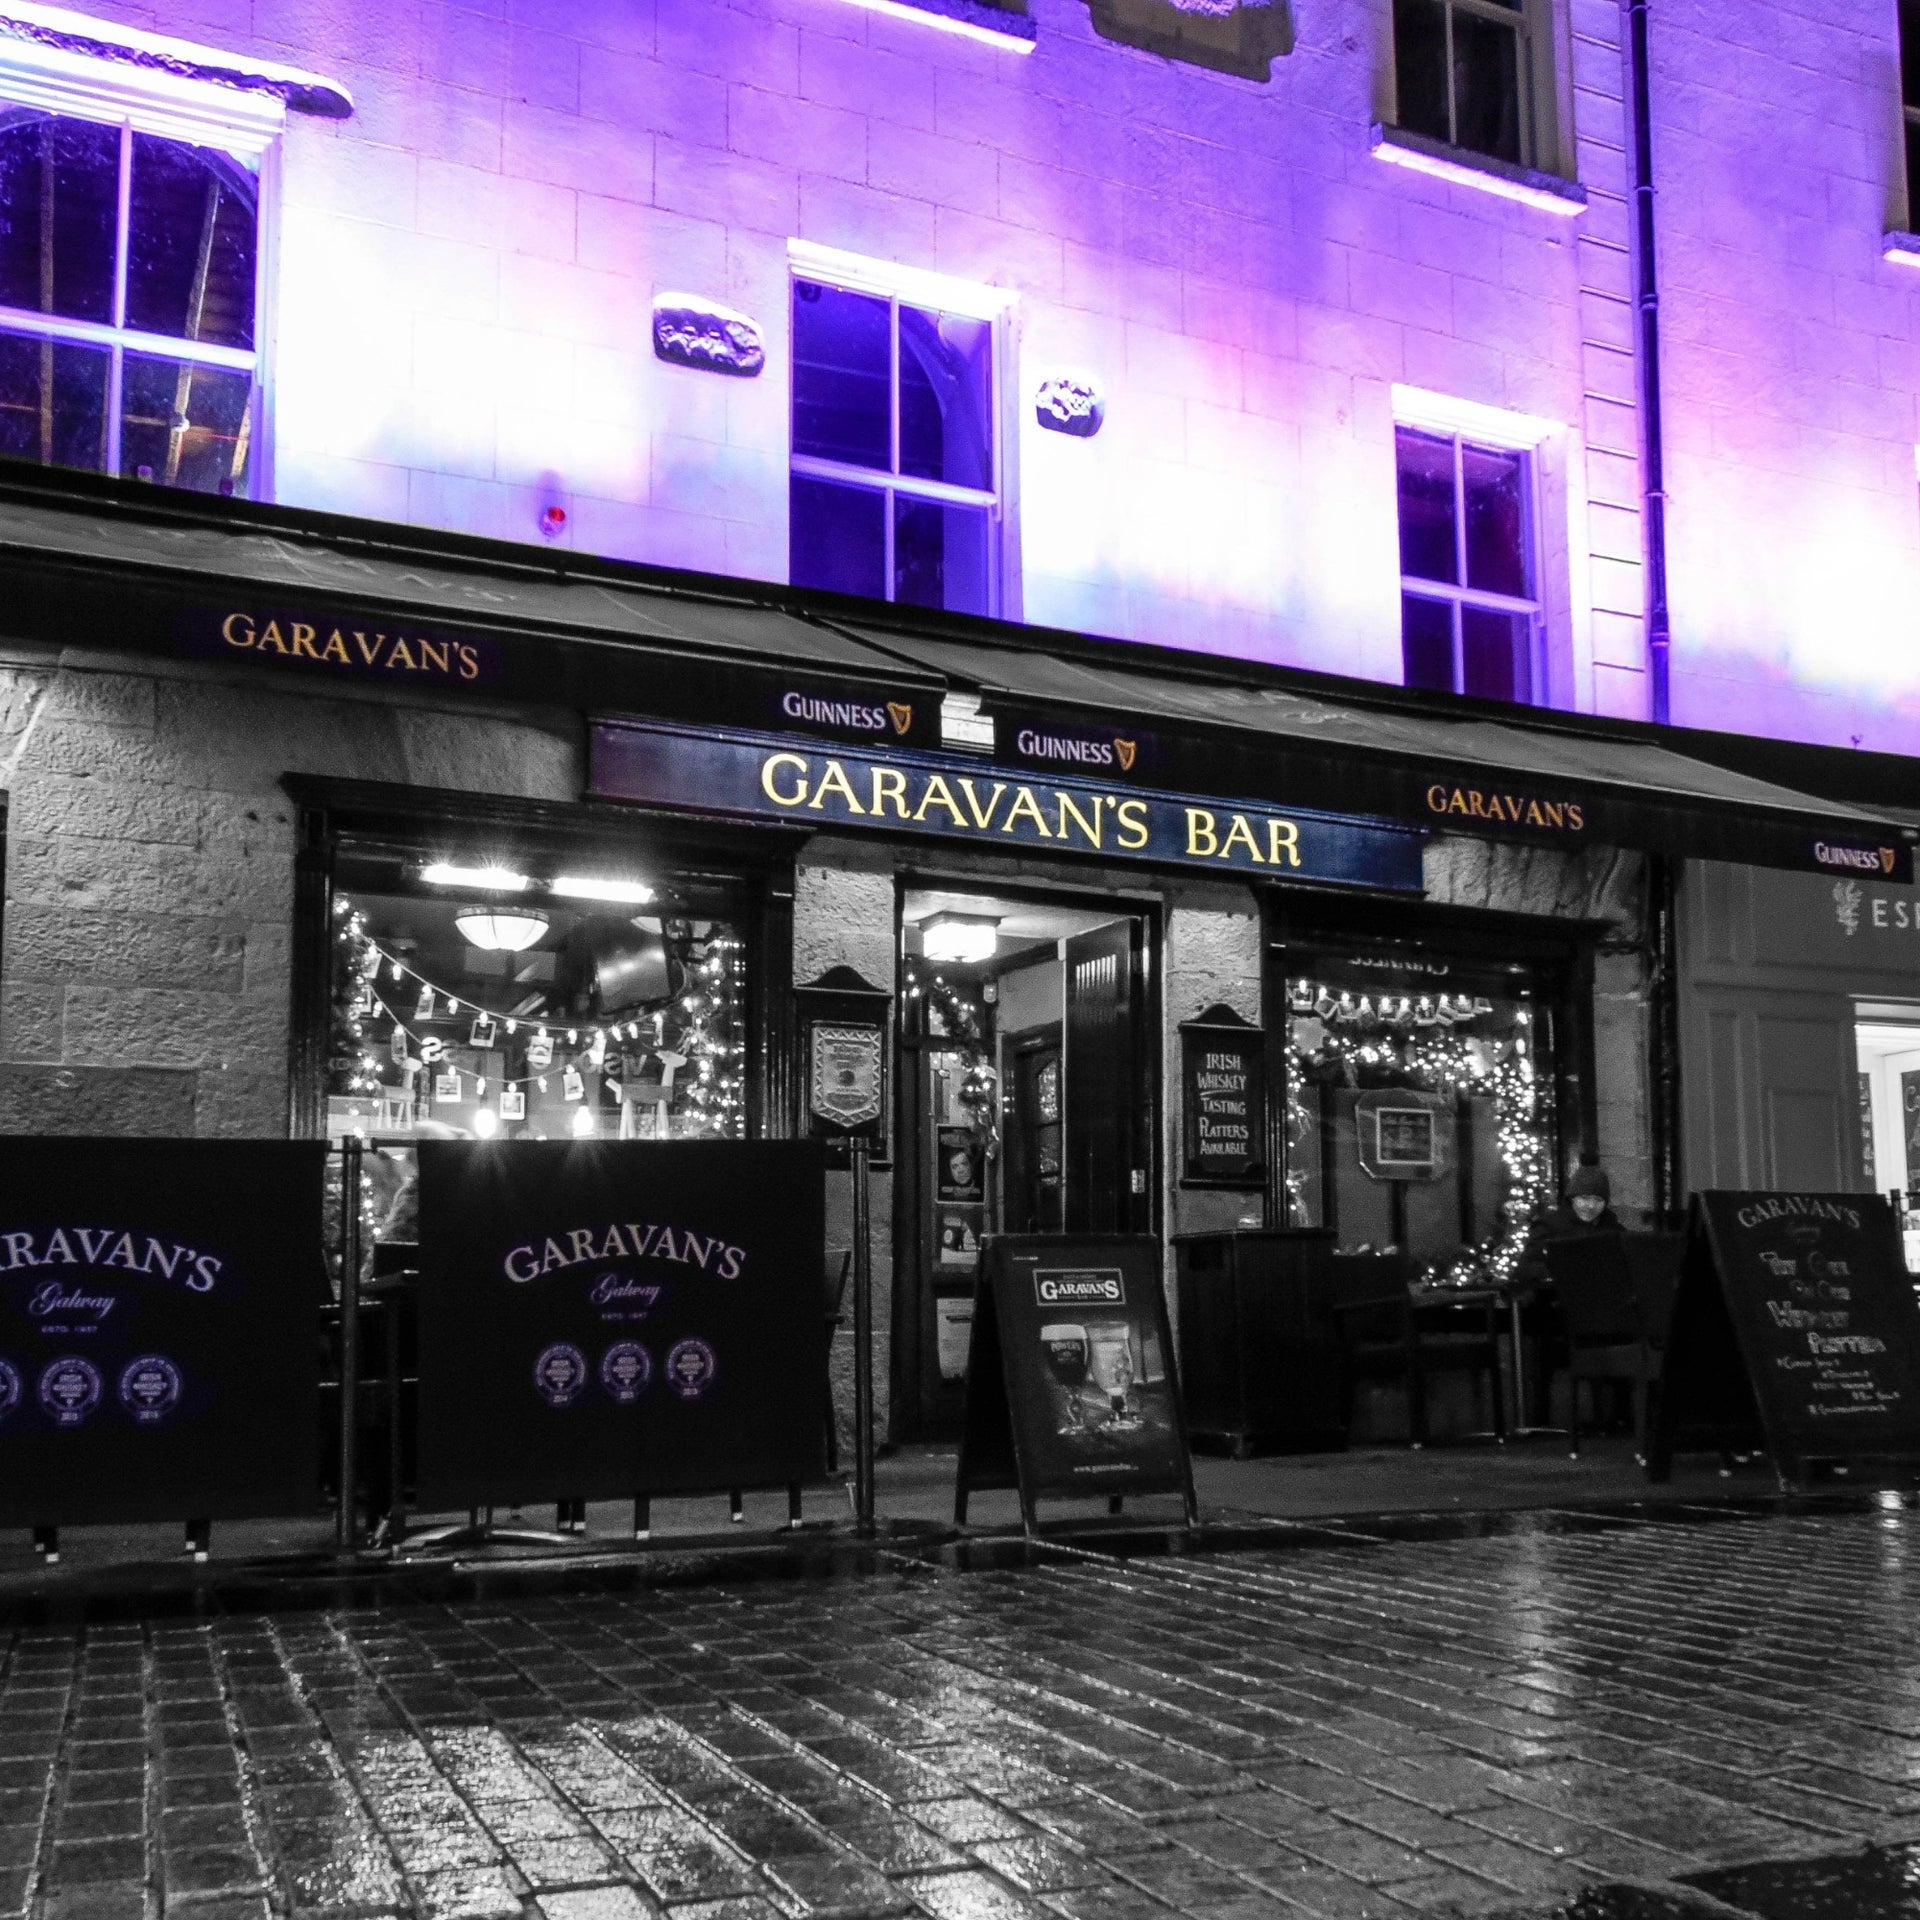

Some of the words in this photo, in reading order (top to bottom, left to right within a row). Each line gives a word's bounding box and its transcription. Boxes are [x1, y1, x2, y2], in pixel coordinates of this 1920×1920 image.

[222, 612, 479, 680] GARAVAN'S
[782, 692, 886, 730] GUINNESS
[1017, 729, 1113, 765] GUINNESS
[761, 753, 1149, 850] GARAVAN'S
[1185, 807, 1302, 868] BAR
[1427, 784, 1585, 830] GARAVAN'S
[1814, 841, 1880, 869] GUINNESS
[1206, 1053, 1241, 1070] IRISH
[1197, 1072, 1247, 1091] WHISKEY
[1200, 1097, 1246, 1115] TASTING
[1198, 1117, 1249, 1139] PLATTERS
[1200, 1139, 1248, 1155] AVAILABLE
[0, 1228, 222, 1292] RAVAN'S
[504, 1224, 747, 1283] GARAVAN'S
